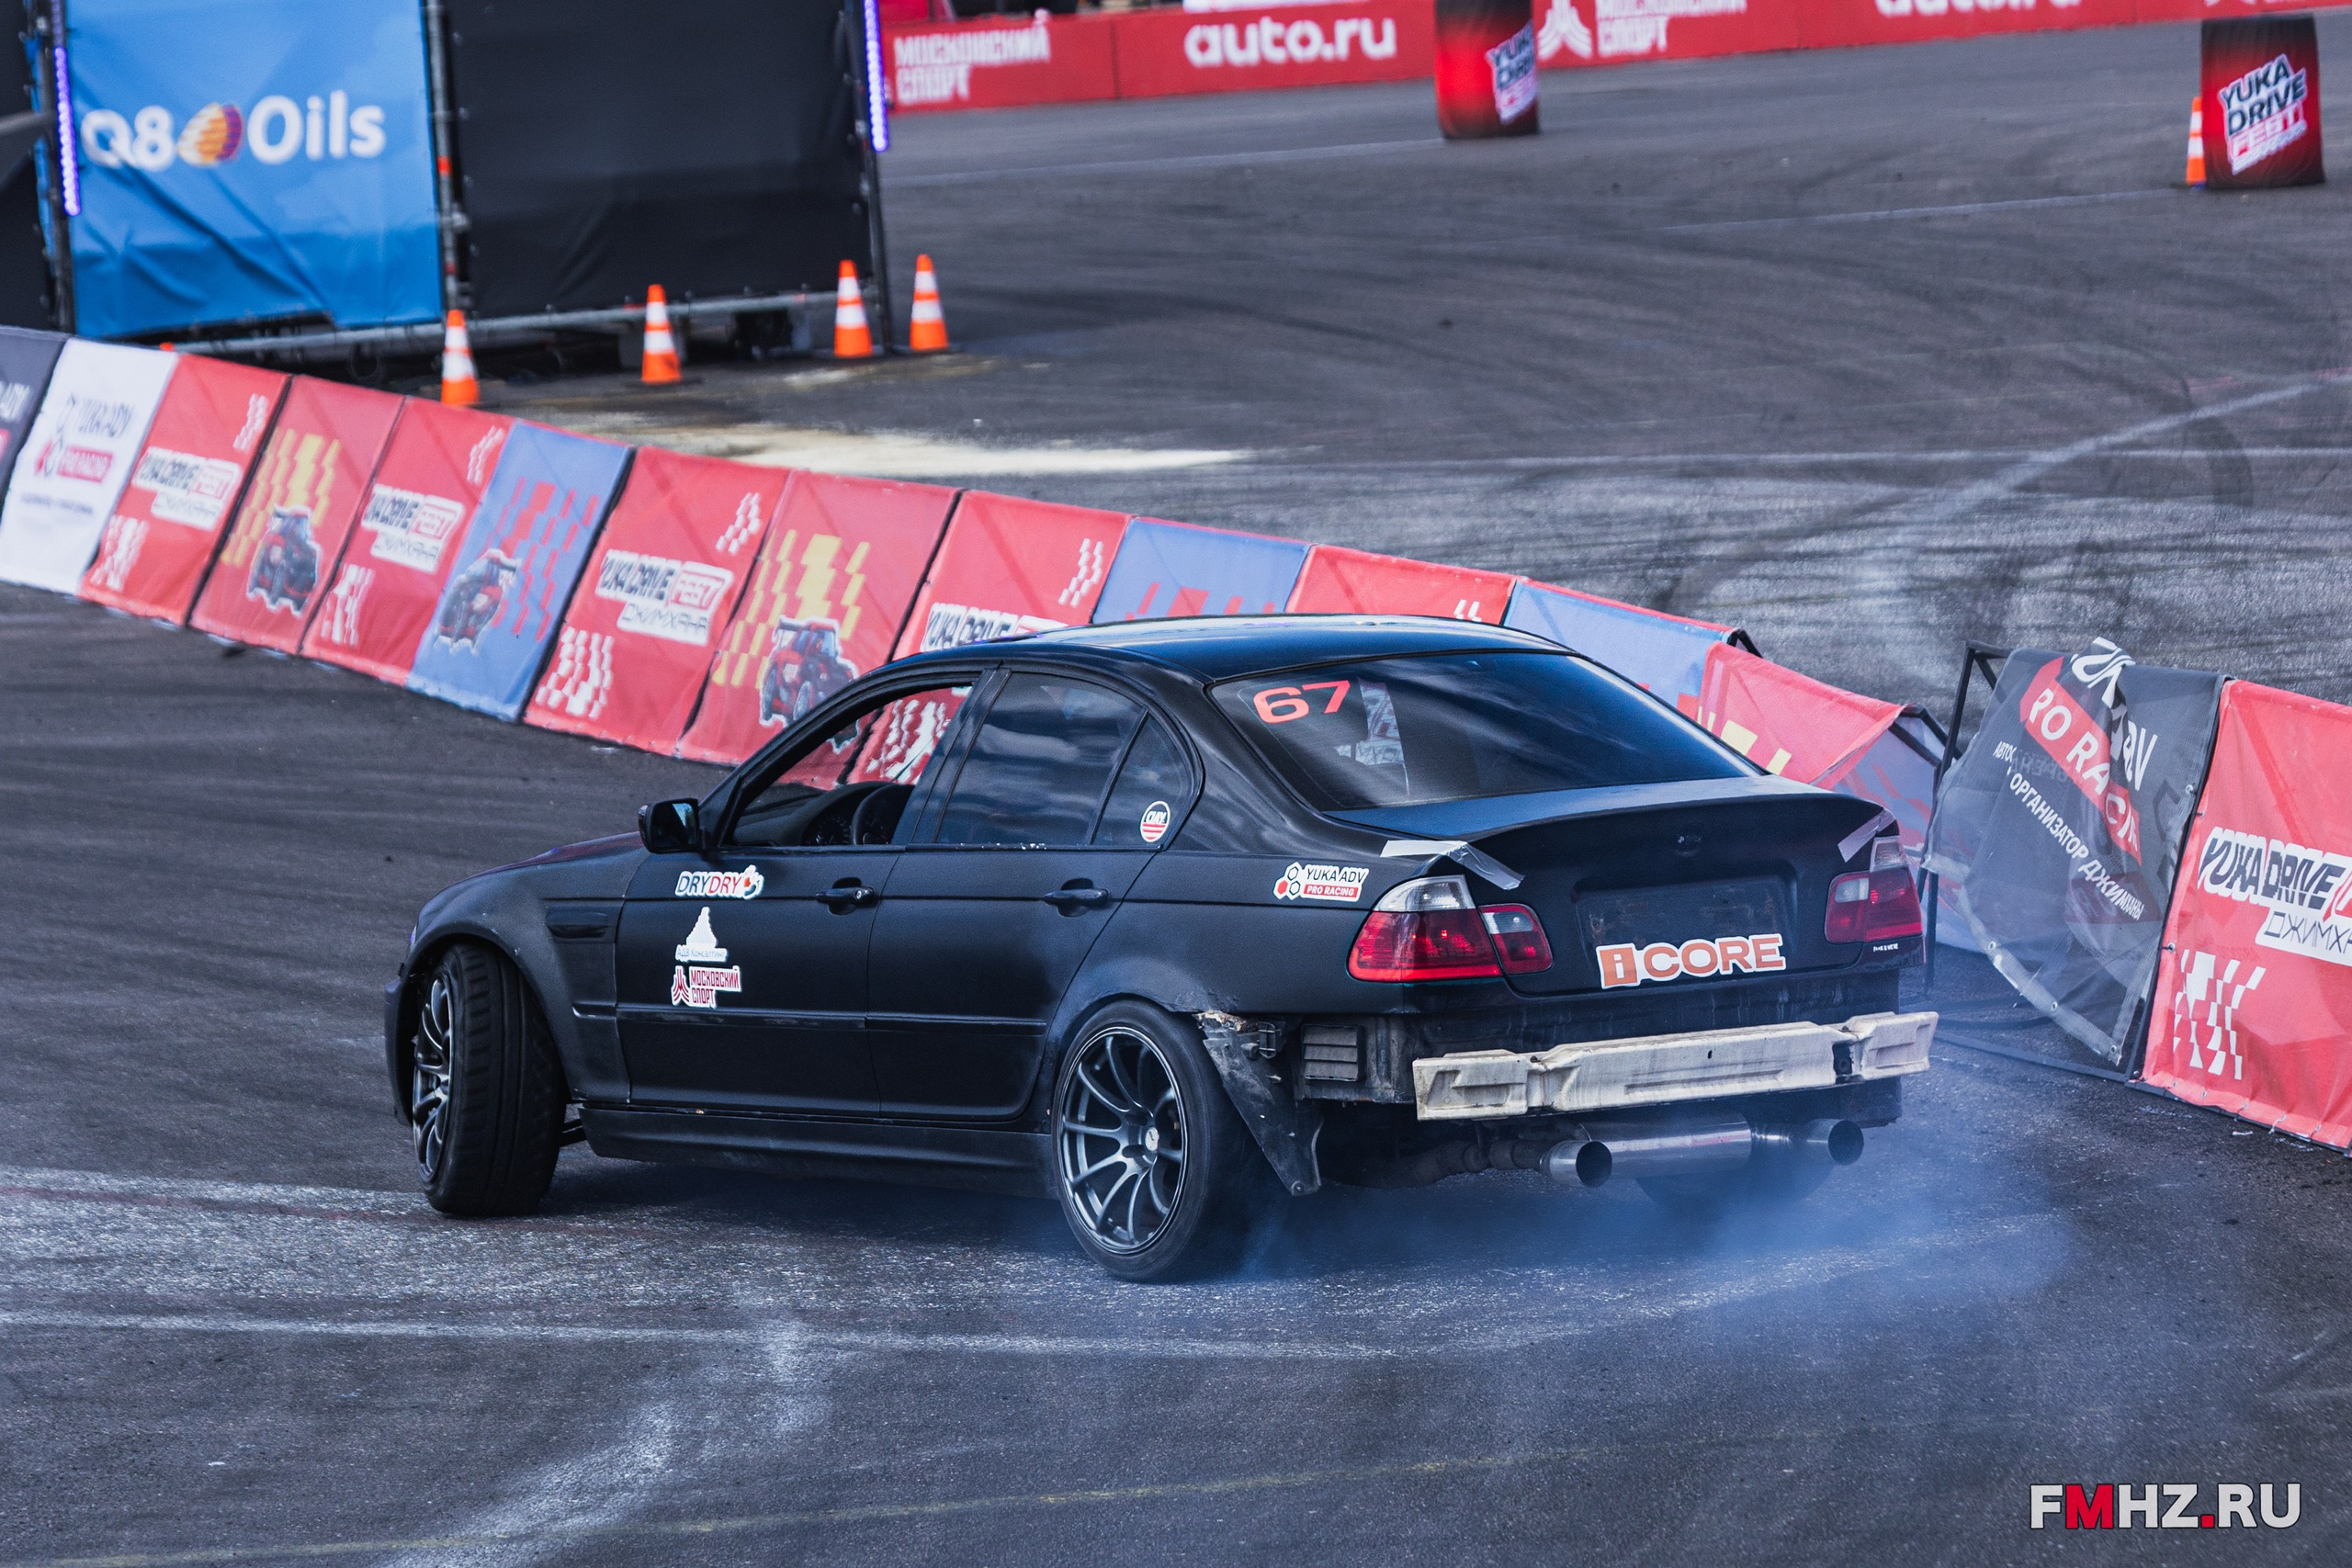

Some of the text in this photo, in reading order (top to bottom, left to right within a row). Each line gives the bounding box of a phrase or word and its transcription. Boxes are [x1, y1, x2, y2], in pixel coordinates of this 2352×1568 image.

[1184, 16, 1397, 67] auto.ru
[2220, 59, 2290, 110] YUKA
[2228, 73, 2306, 137] DRIVE
[82, 91, 387, 172] Q8 Oils
[625, 562, 677, 602] DRIVE
[669, 570, 726, 611] FEST
[1253, 679, 1351, 724] 67
[2009, 773, 2090, 860] ОРГАНИЗАТОР
[2077, 859, 2145, 921] ДЖИМХАНЫ
[677, 875, 742, 895] DRYDRY
[1306, 867, 1366, 884] YUKA ADV
[1306, 886, 1355, 897] PRO RACING
[2199, 837, 2263, 896] YUKA
[2260, 850, 2347, 910] DRIVE
[690, 967, 740, 988] МОСКОВСКИЙ
[691, 987, 714, 1004] СПОРТ
